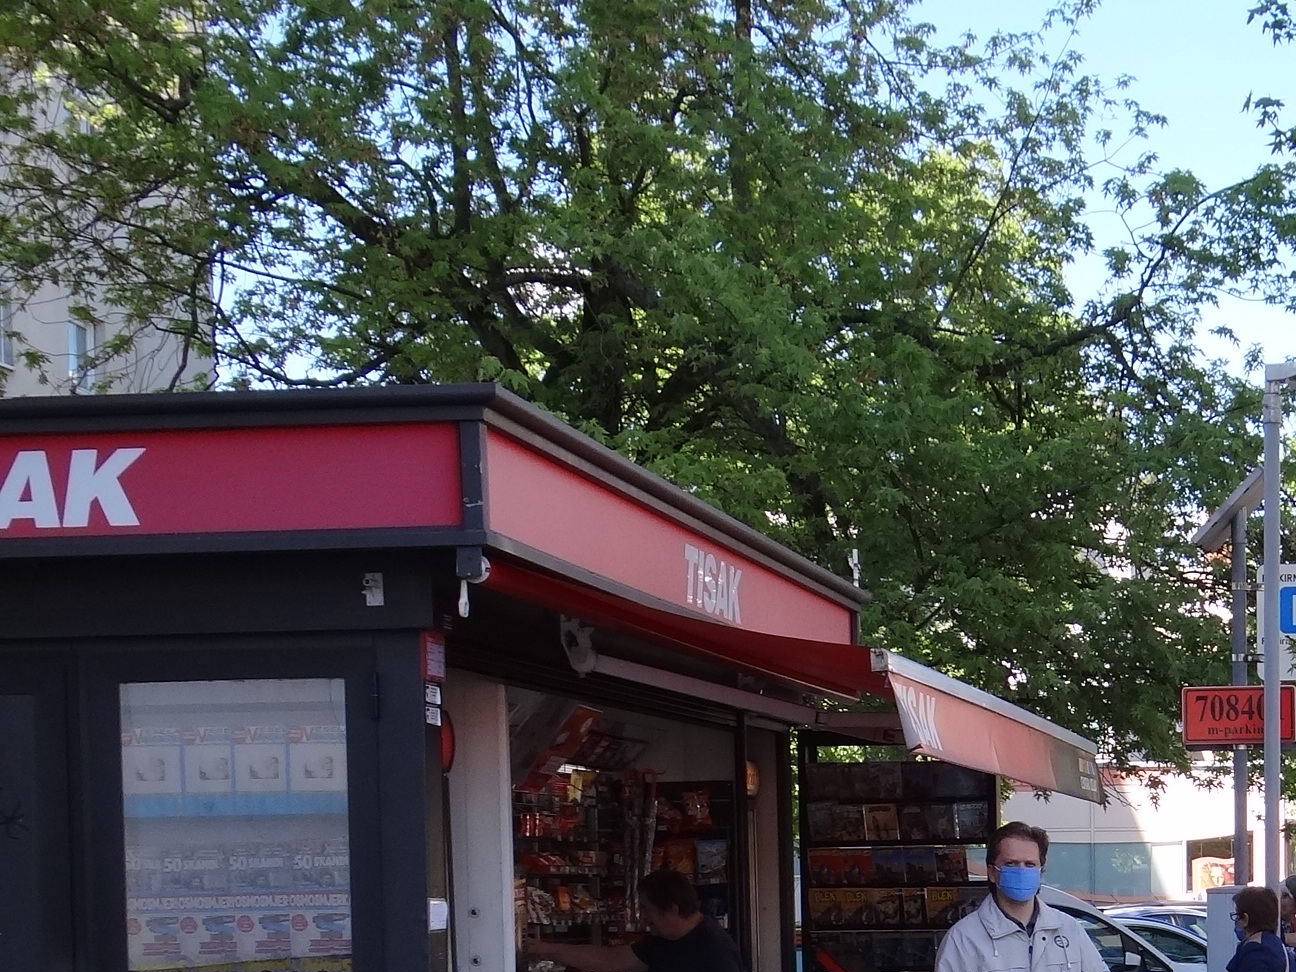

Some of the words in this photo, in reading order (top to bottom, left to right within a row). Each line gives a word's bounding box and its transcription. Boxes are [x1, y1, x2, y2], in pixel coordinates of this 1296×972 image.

[684, 543, 742, 625] TISAK
[1207, 723, 1265, 737] m-parkin
[931, 890, 954, 901] BLEK
